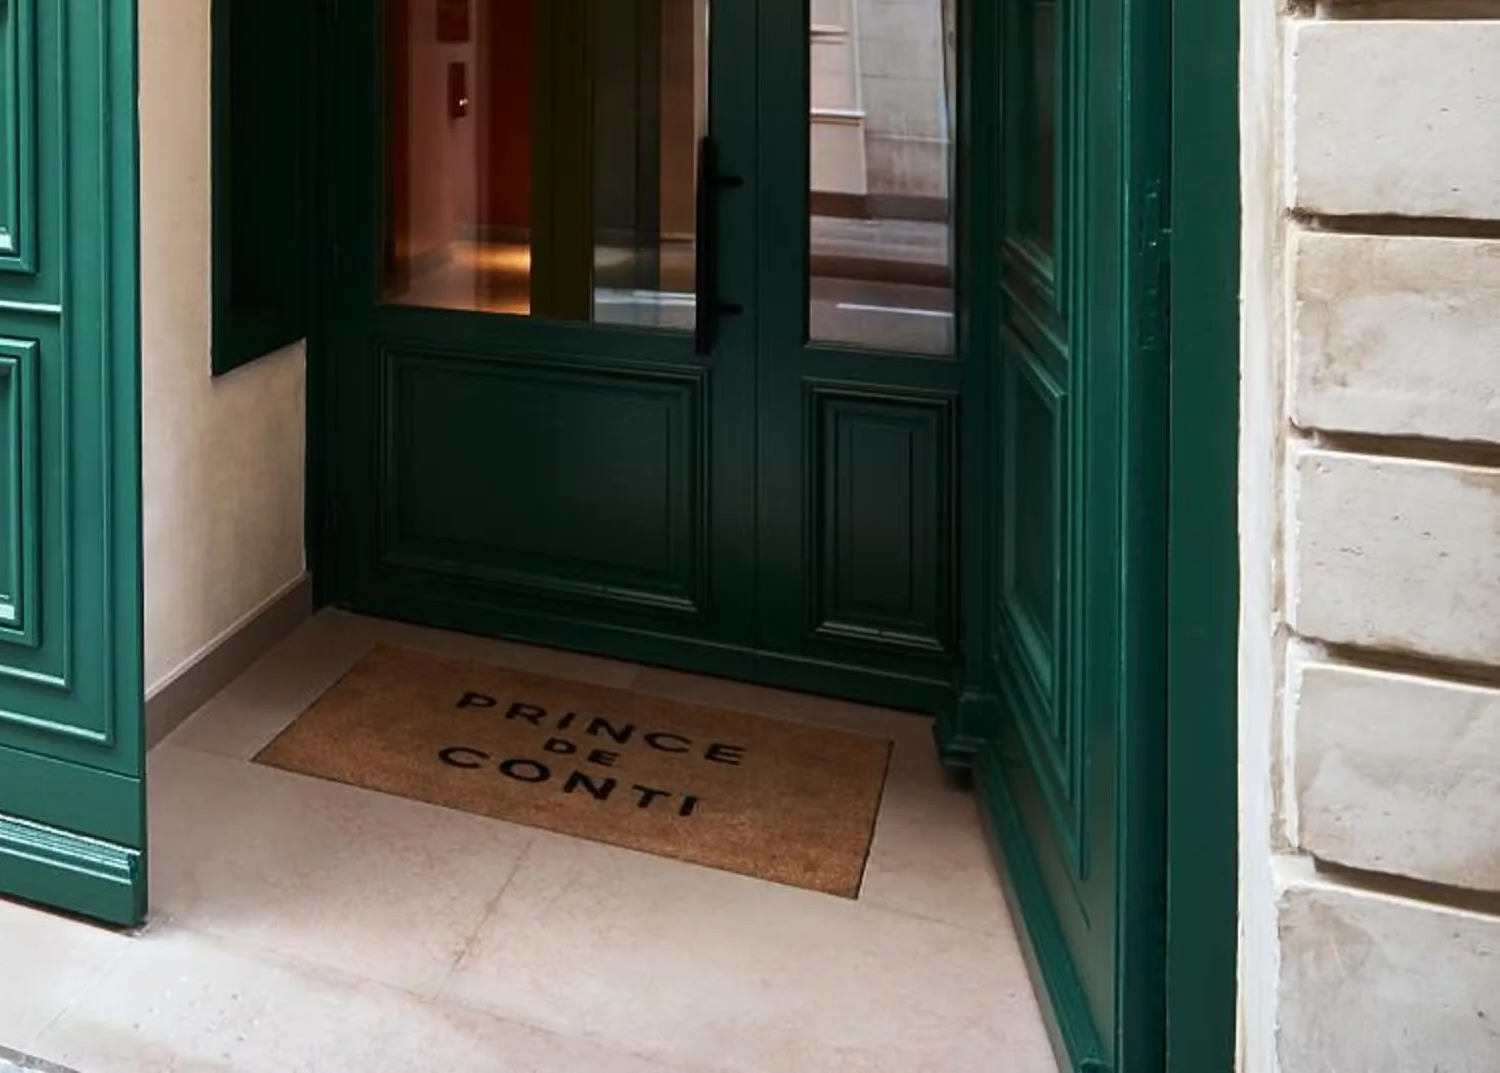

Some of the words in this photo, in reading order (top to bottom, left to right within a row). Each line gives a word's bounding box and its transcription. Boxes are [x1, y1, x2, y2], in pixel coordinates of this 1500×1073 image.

[455, 691, 748, 766] PRINCE
[543, 738, 622, 767] DE
[438, 745, 698, 817] CONTI
